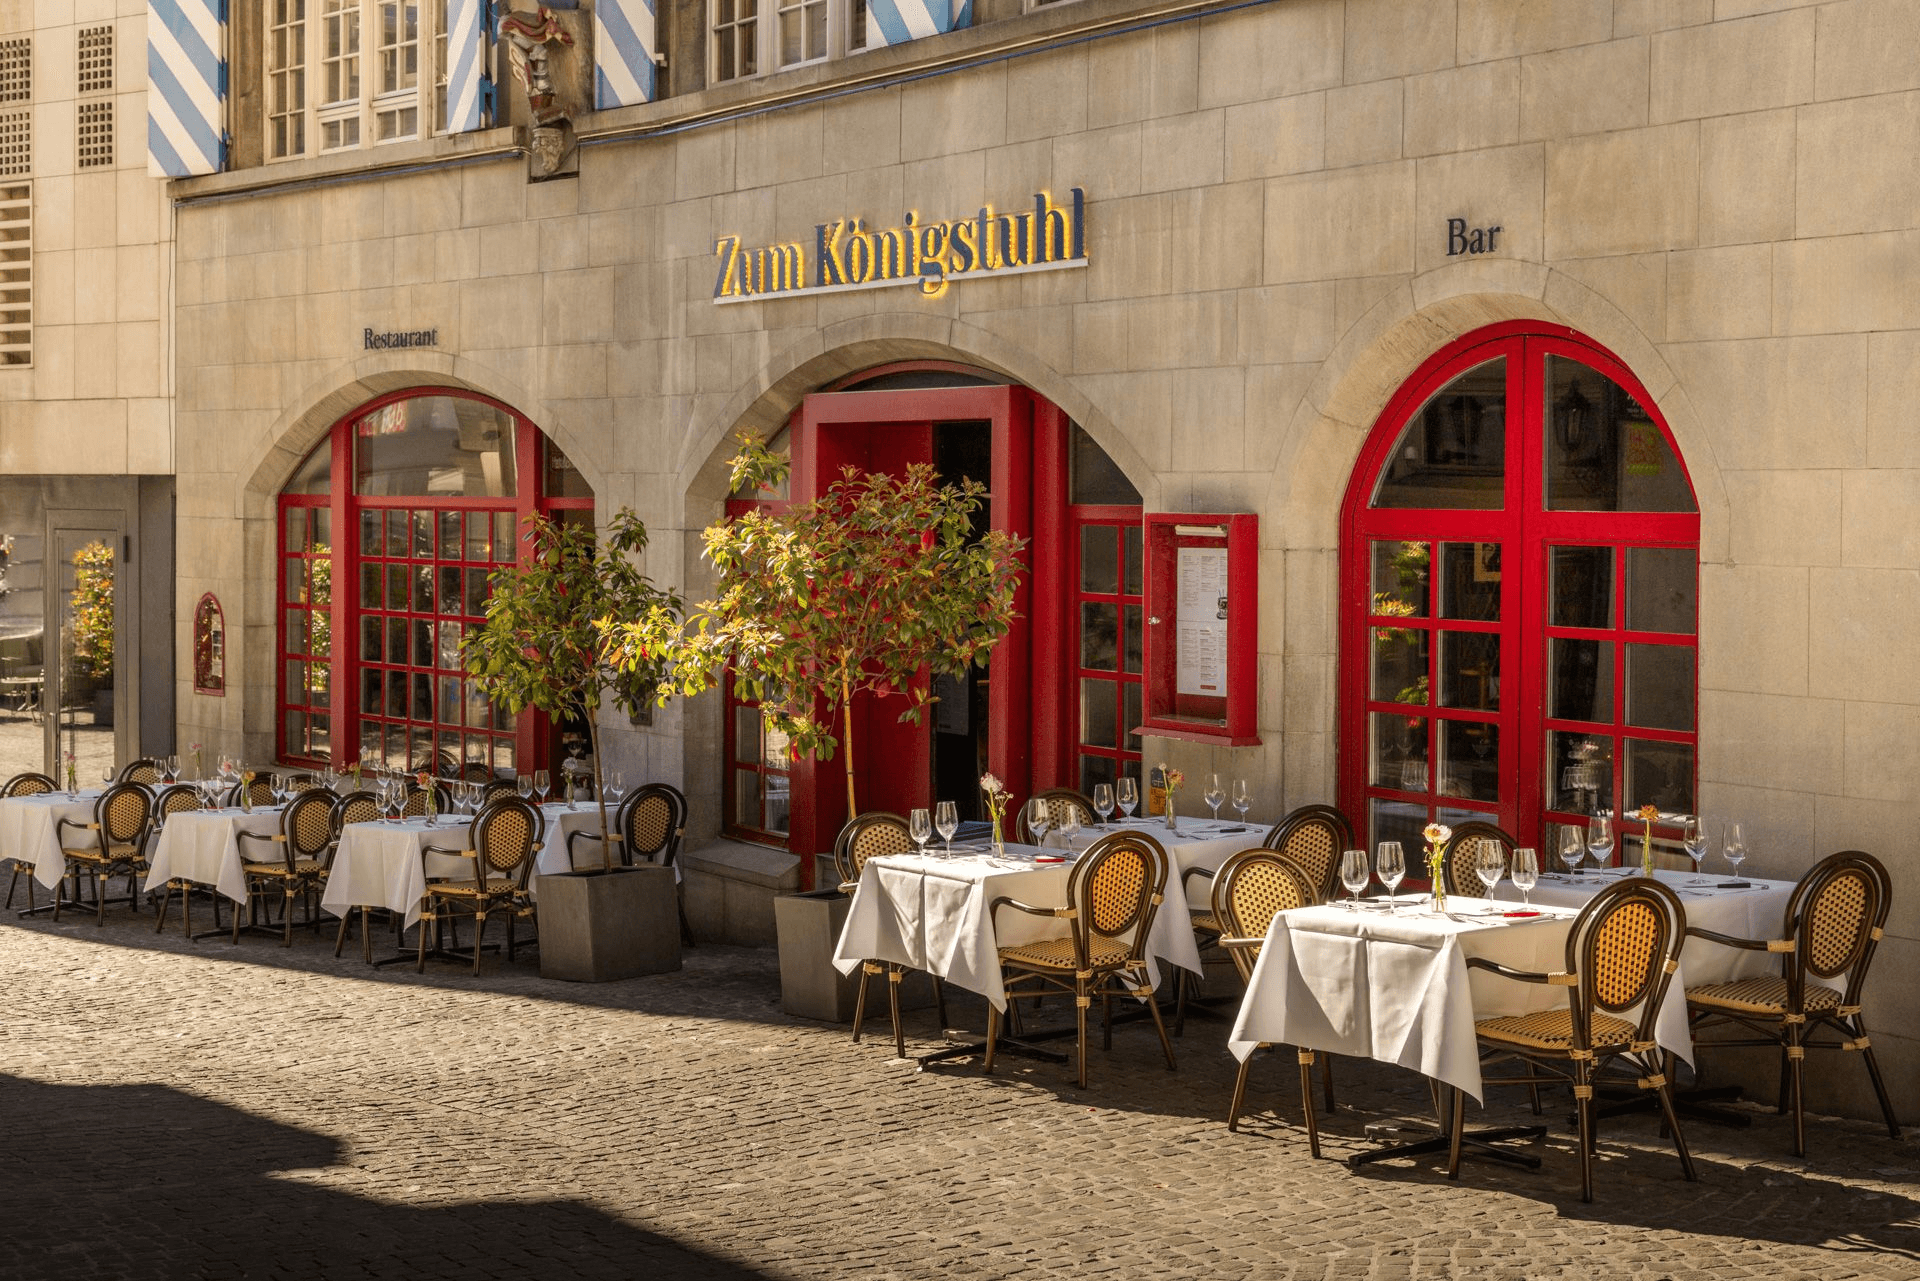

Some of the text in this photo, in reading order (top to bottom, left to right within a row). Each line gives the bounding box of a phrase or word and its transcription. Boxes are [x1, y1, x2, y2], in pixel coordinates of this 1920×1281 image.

[713, 187, 1086, 298] Zum Königstuhl
[1446, 218, 1503, 256] Bar
[364, 328, 438, 350] Restaurant
